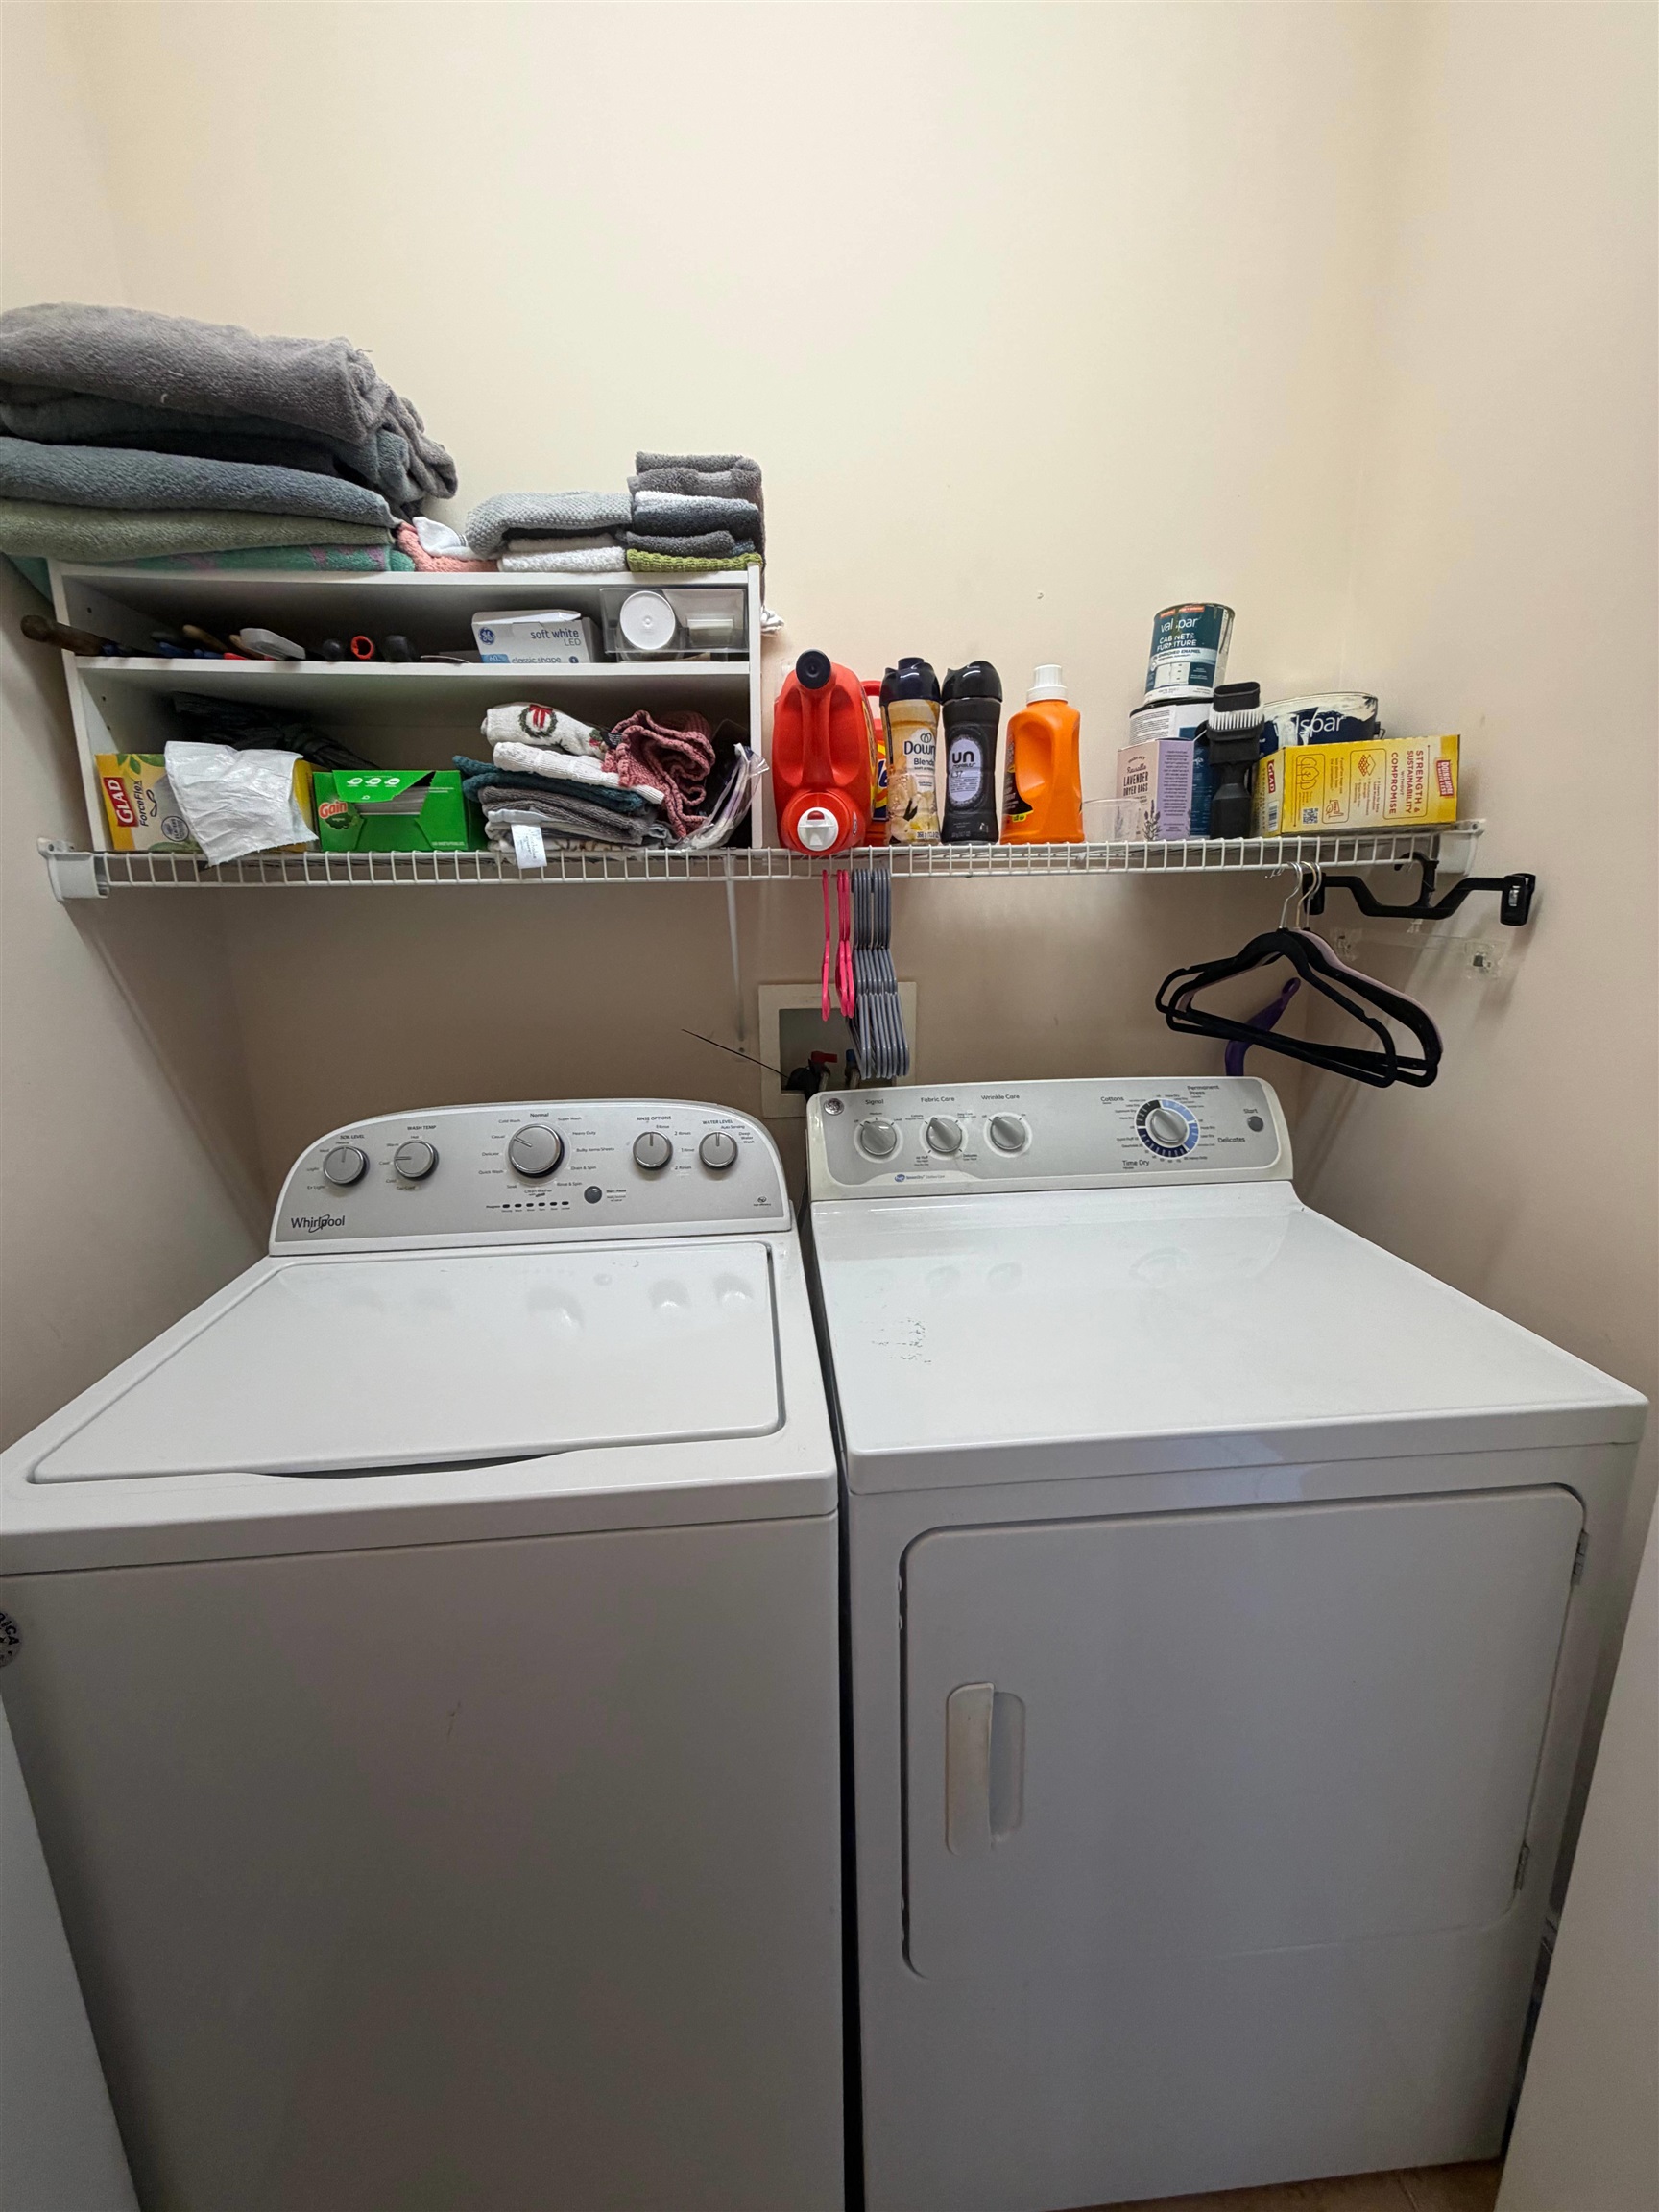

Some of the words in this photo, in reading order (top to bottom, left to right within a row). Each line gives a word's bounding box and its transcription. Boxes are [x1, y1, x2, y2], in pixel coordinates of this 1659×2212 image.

[530, 629, 551, 639] soft
[552, 627, 580, 637] white
[1161, 618, 1198, 633] valpar
[1159, 634, 1190, 644] CABNET
[904, 740, 936, 755] Down
[1123, 771, 1149, 786] LAVENDER
[1389, 752, 1399, 814] COMPROMISE
[1406, 750, 1414, 813] SUSTAINABILITY
[1123, 784, 1136, 796] DRYER
[1137, 783, 1148, 793] BAGS
[108, 779, 134, 824] GLAD
[133, 780, 149, 827] ForceFlex
[319, 801, 348, 820] Gain
[291, 1214, 346, 1232] Whirlpool
